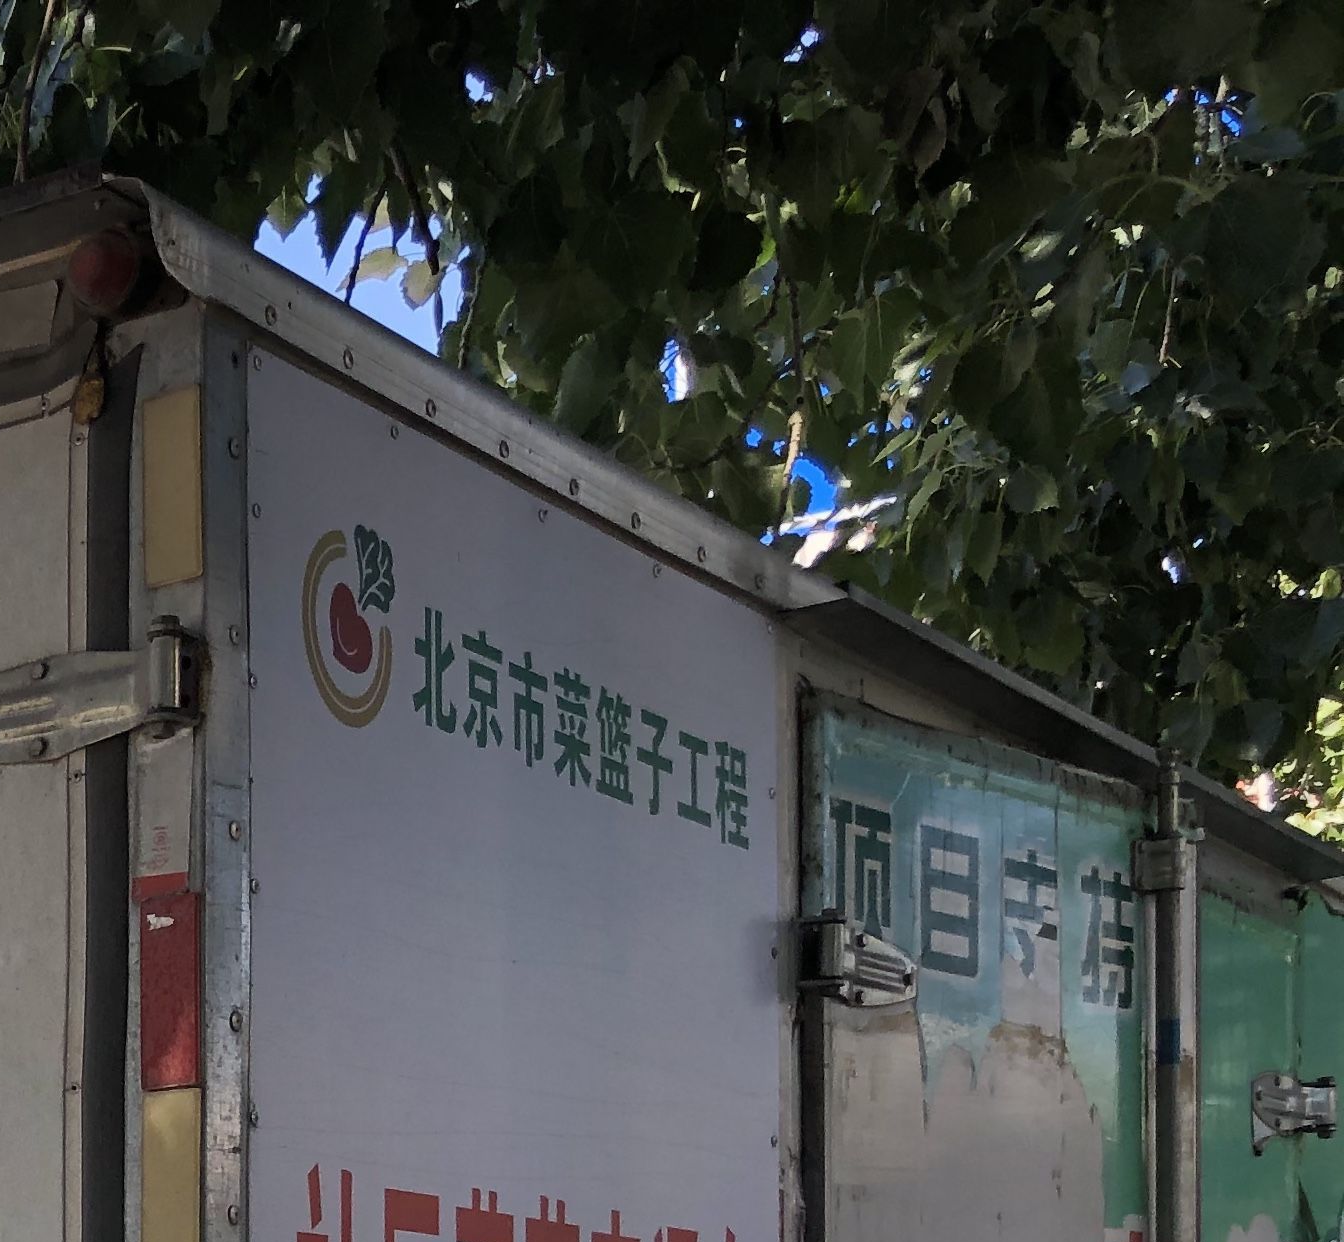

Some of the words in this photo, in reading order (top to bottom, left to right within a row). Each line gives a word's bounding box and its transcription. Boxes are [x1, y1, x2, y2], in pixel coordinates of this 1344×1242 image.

[412, 606, 750, 850] 北京市菜篮子工程
